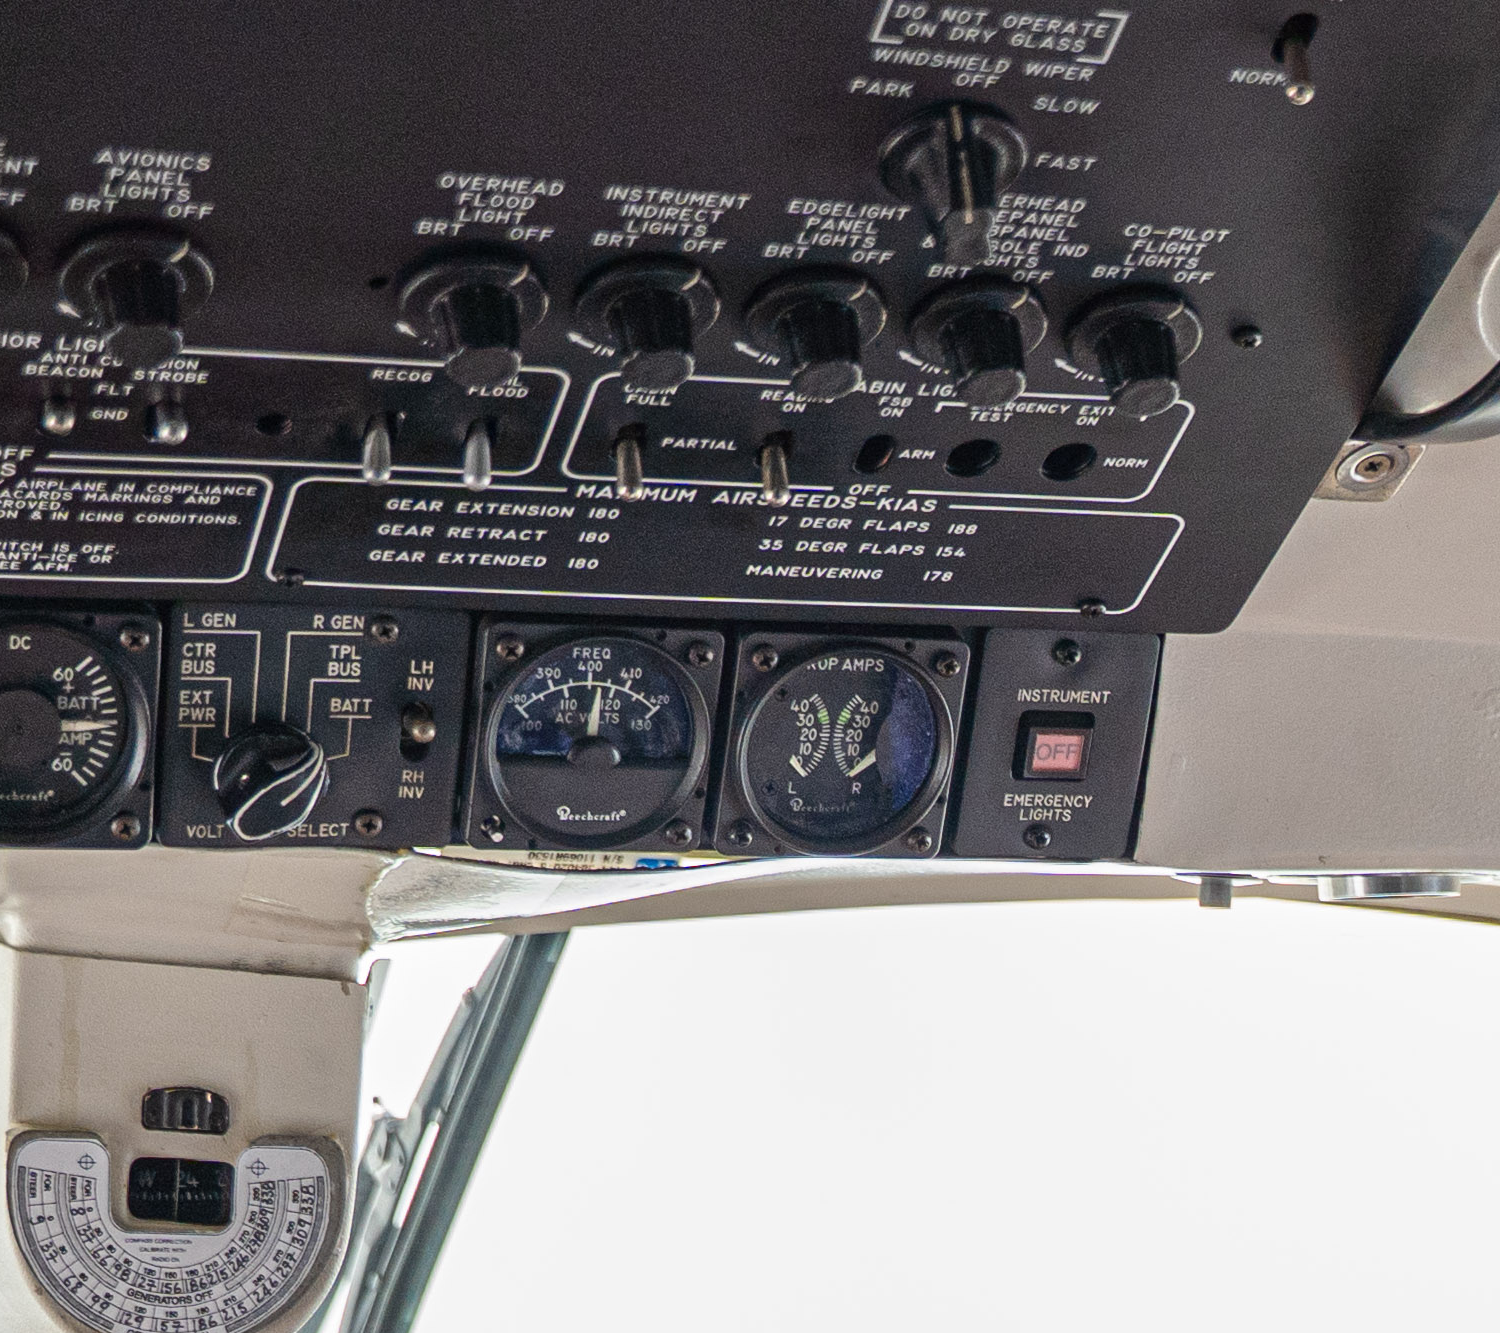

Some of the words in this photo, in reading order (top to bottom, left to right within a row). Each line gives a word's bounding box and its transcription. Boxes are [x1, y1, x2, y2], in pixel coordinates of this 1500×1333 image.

[894, 3, 926, 19] DO
[940, 7, 989, 26] NOT
[1002, 15, 1109, 39] OPERATE
[904, 23, 936, 38] ON
[949, 27, 996, 44] DRY
[1010, 34, 1087, 53] GLASS
[873, 48, 1011, 74] WINDSHIELD
[1024, 62, 1097, 82] WIPER
[851, 78, 914, 98] PARK
[955, 73, 1001, 90] OFF
[1033, 97, 1101, 115] SLOW
[96, 150, 211, 172] AVIONICS
[1035, 154, 1097, 172] FAST
[109, 167, 190, 187] PANEL
[439, 173, 565, 197] OVERHEAD
[103, 183, 191, 203] LIGHTS
[605, 185, 750, 210] INSTRUMENT
[457, 193, 536, 211] FLOOD
[458, 209, 527, 225] LIGHT
[621, 204, 725, 223] INDIRECT
[788, 201, 911, 221] EDGELIGHT
[417, 220, 465, 238] BRT
[509, 227, 555, 242] OFF
[626, 221, 708, 238] LIGHTS
[806, 217, 879, 235] PANEL
[1124, 224, 1232, 243] CO-PILOT
[593, 232, 640, 249] BRT
[681, 239, 726, 254] OFF
[798, 232, 876, 250] LIGHTS
[1132, 240, 1207, 256] FLIGHT
[763, 245, 807, 260] BRT
[851, 251, 896, 265] OFF
[1053, 245, 1089, 258] IND
[1124, 254, 1200, 270] LIGHTS
[1091, 266, 1135, 279] BRT
[1174, 271, 1215, 284] OFF
[25, 364, 104, 378] BEACON
[134, 369, 209, 384] STROBE
[372, 369, 432, 382] RECOG
[97, 384, 134, 398] FLT
[92, 408, 128, 422] GND
[970, 411, 1014, 423] TEST
[661, 438, 738, 450] PARTIAL
[899, 449, 935, 460] ARM
[1103, 458, 1149, 469] NORM
[386, 500, 443, 512] GEAR
[456, 503, 575, 518] EXTENSION
[588, 508, 620, 520] 180
[53, 512, 68, 521] IN
[80, 513, 124, 523] ICING
[135, 514, 241, 525] CONDITIONS.
[769, 516, 788, 526] 17
[800, 518, 850, 530] DEGR
[863, 520, 930, 533] FLAPS
[948, 524, 978, 535] 188
[378, 525, 434, 537] GEAR
[448, 527, 547, 541] RETRACT
[579, 532, 610, 543] 180
[759, 540, 783, 550] 35
[796, 541, 847, 552] DEGR
[859, 543, 925, 556] FLAPS
[936, 547, 966, 557] 154
[369, 551, 425, 562] GEAR
[438, 553, 547, 567] EXTENDED
[568, 559, 599, 570] 180
[746, 566, 883, 580] MANEUVERING
[923, 571, 953, 582] 178
[184, 613, 194, 627] L
[202, 613, 236, 627] GEN
[313, 615, 324, 629] R
[331, 616, 365, 630] GEN
[10, 635, 31, 650] DC
[183, 643, 216, 658] CTR
[330, 645, 362, 659] TPL
[573, 648, 611, 660] FREQ
[181, 660, 215, 674] BUS
[328, 662, 361, 676] BUS
[411, 660, 434, 675] LH
[578, 662, 603, 672] 400
[842, 659, 884, 672] AMPS
[620, 668, 642, 679] 410
[408, 678, 434, 691] INV
[58, 696, 100, 710] BATT
[180, 691, 213, 705] EXT
[1017, 689, 1111, 704] INSTRUMENT
[330, 699, 372, 713] BATT
[179, 708, 216, 721] PWR
[1036, 743, 1079, 761] OFF
[402, 771, 424, 783] RH
[399, 786, 424, 799] INV
[1003, 793, 1093, 808] EMERGENCY
[1019, 808, 1072, 822] LIGHTS
[186, 825, 224, 838] VOLT
[287, 823, 349, 837] SELECT
[126, 1289, 193, 1305] GENERATORS
[195, 1290, 214, 1302] OFF
